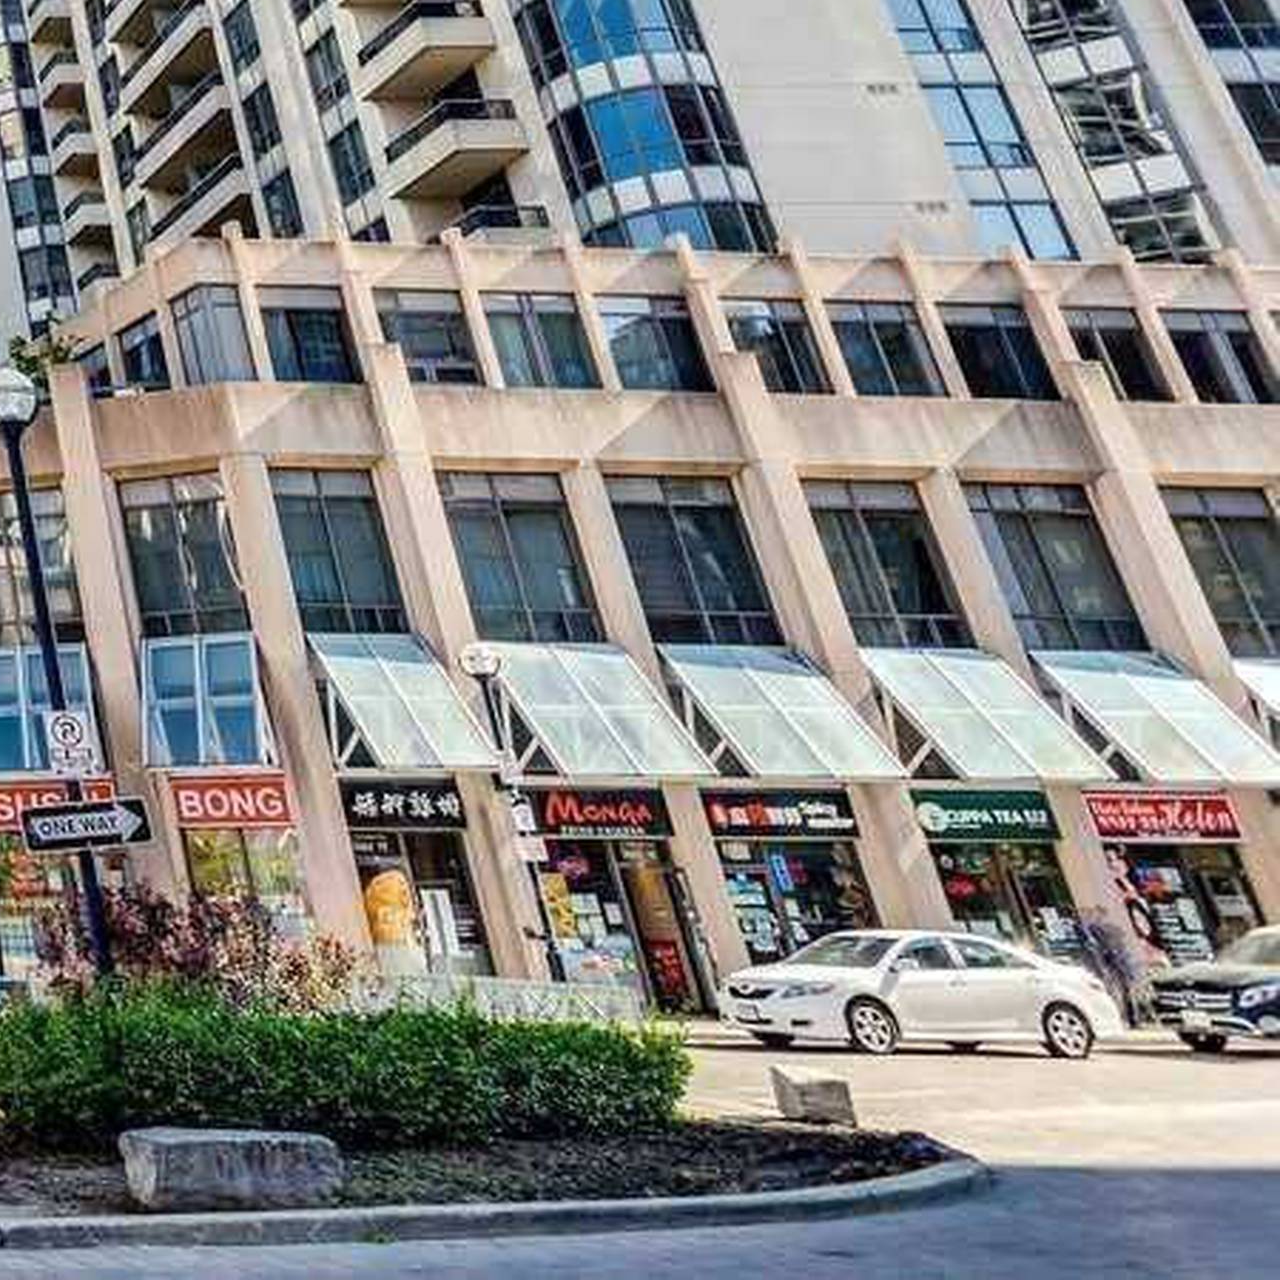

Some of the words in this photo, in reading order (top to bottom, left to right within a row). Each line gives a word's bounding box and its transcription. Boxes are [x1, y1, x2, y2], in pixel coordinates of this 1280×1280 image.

[179, 787, 285, 818] BONG
[40, 818, 77, 836] ONE
[79, 815, 118, 833] WAY
